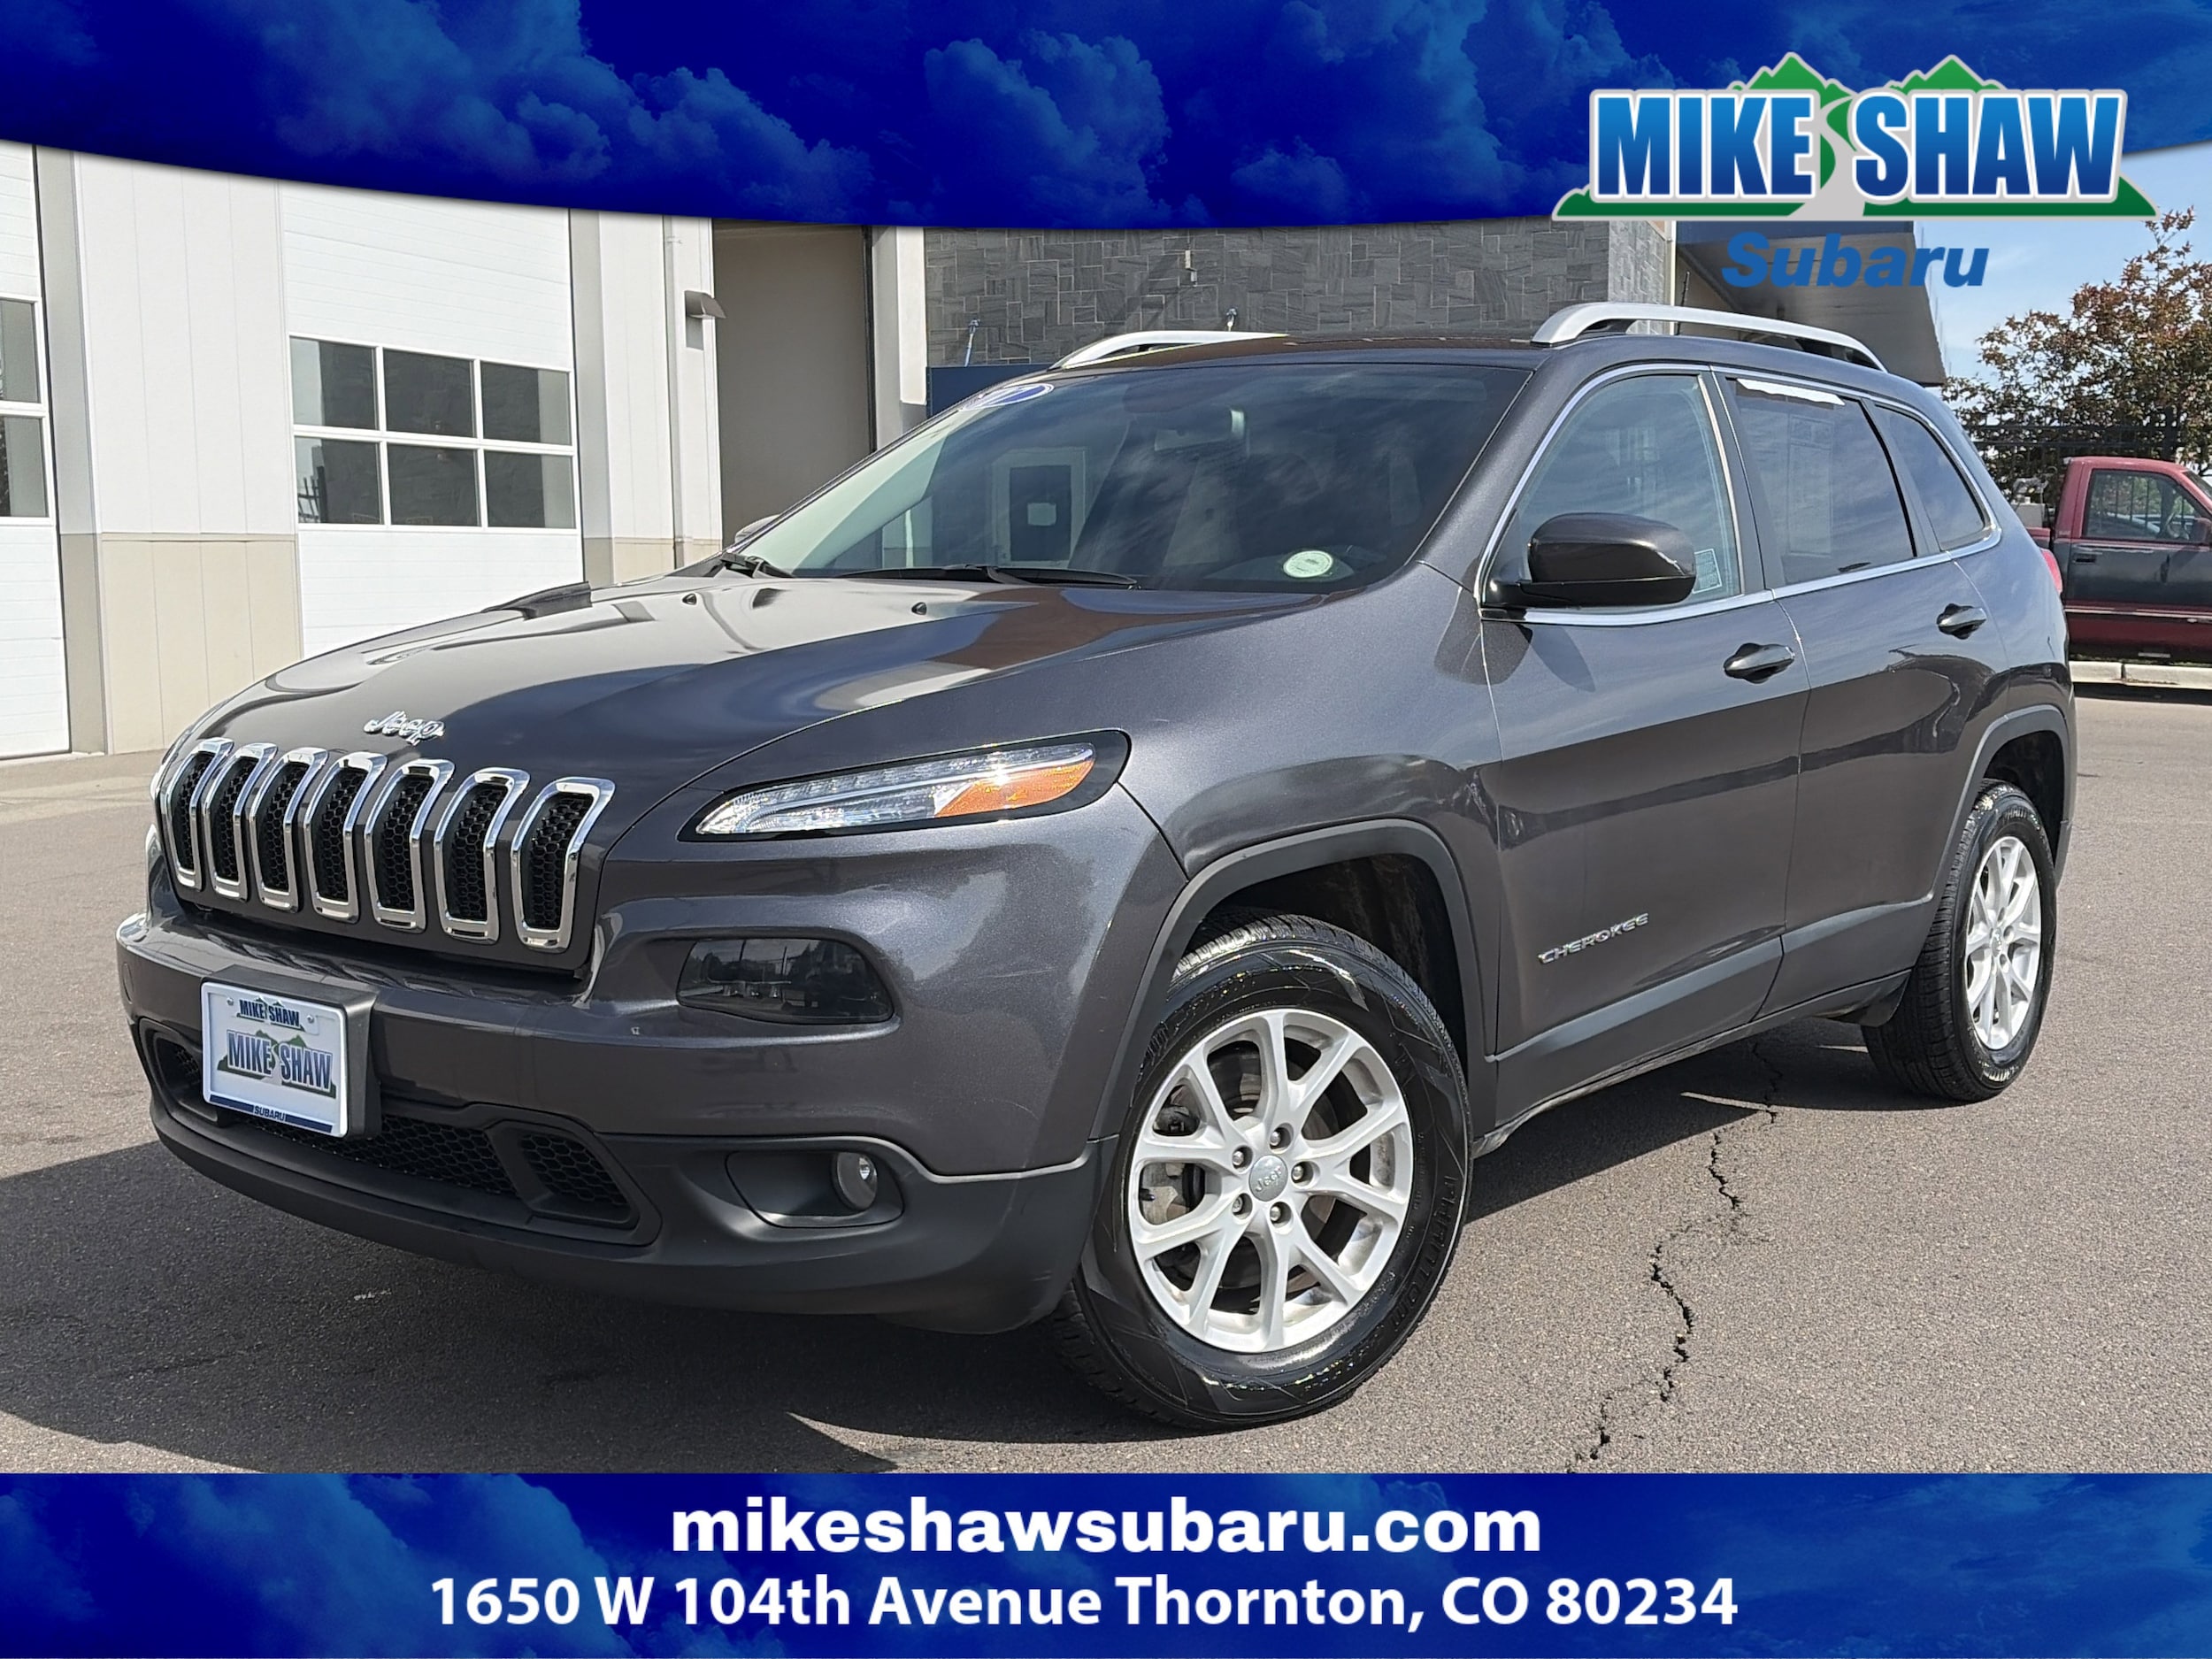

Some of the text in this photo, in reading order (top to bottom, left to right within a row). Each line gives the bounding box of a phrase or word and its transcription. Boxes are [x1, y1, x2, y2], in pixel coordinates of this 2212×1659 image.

[363, 710, 445, 746] Jeep
[1538, 912, 1649, 964] CHEROKEE
[239, 999, 301, 1027] MIKE SHAW
[227, 1033, 333, 1090] MIKE SHAW
[254, 1105, 287, 1122] SUBARU
